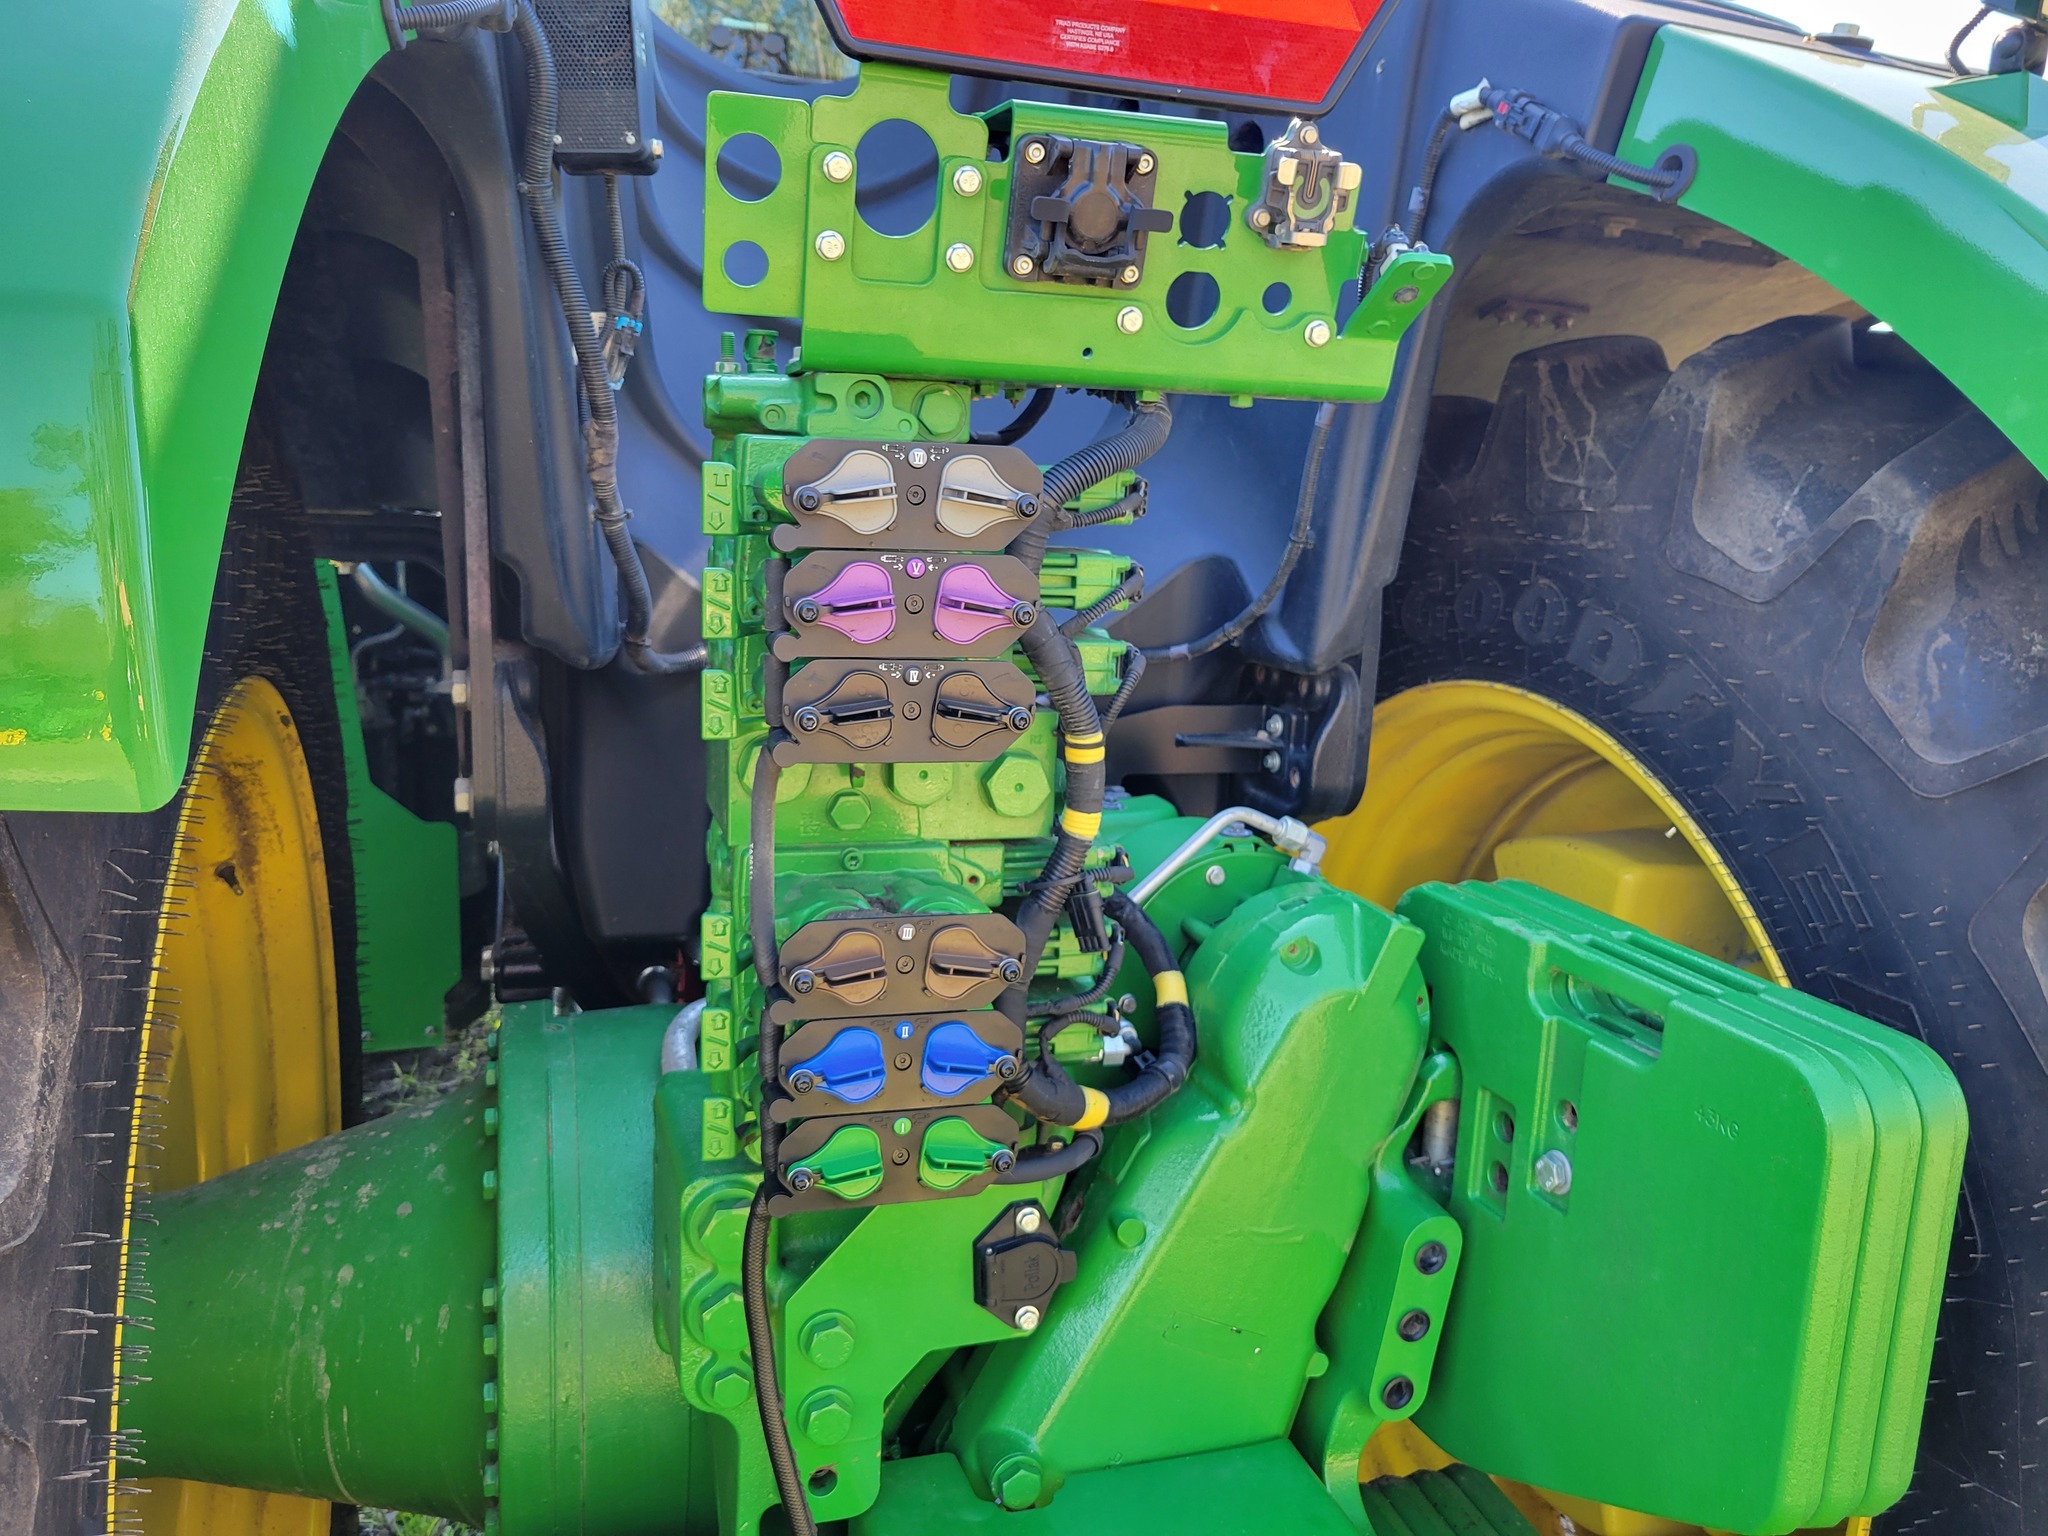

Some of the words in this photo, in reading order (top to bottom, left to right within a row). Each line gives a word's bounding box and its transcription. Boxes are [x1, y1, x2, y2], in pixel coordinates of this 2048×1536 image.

[1055, 19, 1071, 27] TRIAD
[1072, 21, 1099, 30] PRODUCTS
[1101, 25, 1127, 34] COMPANY
[1087, 37, 1121, 47] COMPLIANCE
[913, 451, 924, 465] VI
[911, 562, 922, 575] V
[909, 670, 919, 683] IV
[902, 927, 913, 941] III
[901, 1026, 909, 1038] II
[1024, 1254, 1041, 1293] Pollak
